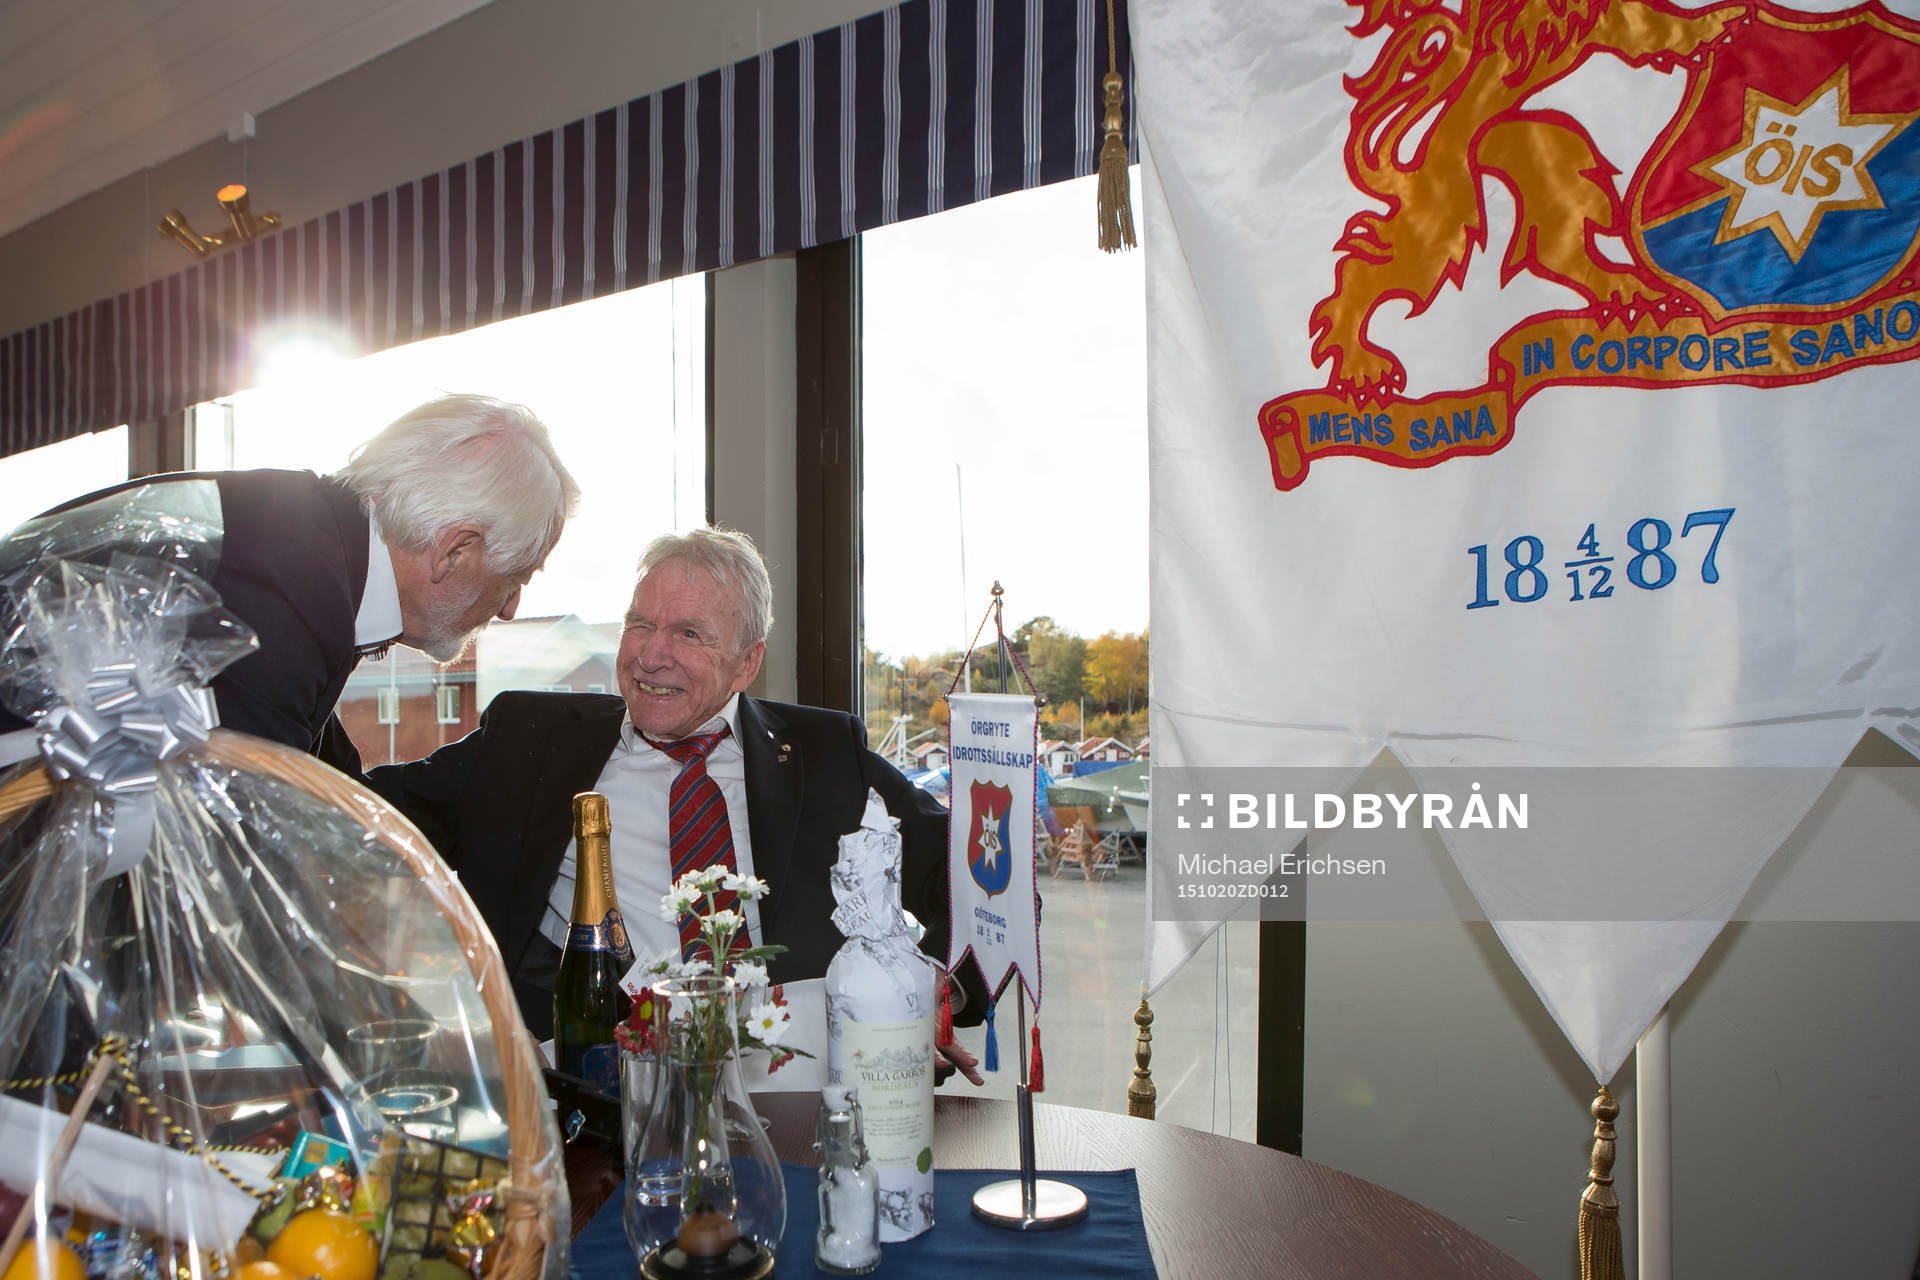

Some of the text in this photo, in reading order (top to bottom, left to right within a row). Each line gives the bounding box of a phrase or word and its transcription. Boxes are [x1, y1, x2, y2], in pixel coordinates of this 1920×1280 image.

[1744, 121, 1853, 198] ÖIS
[1521, 301, 1920, 376] IN CORPORE SANO
[1308, 404, 1497, 451] MENS SANA
[971, 717, 1010, 738] ÖRGRYTE
[952, 745, 1033, 769] IDROTTSSÄLLSKAP
[861, 1071, 890, 1081] VILLA
